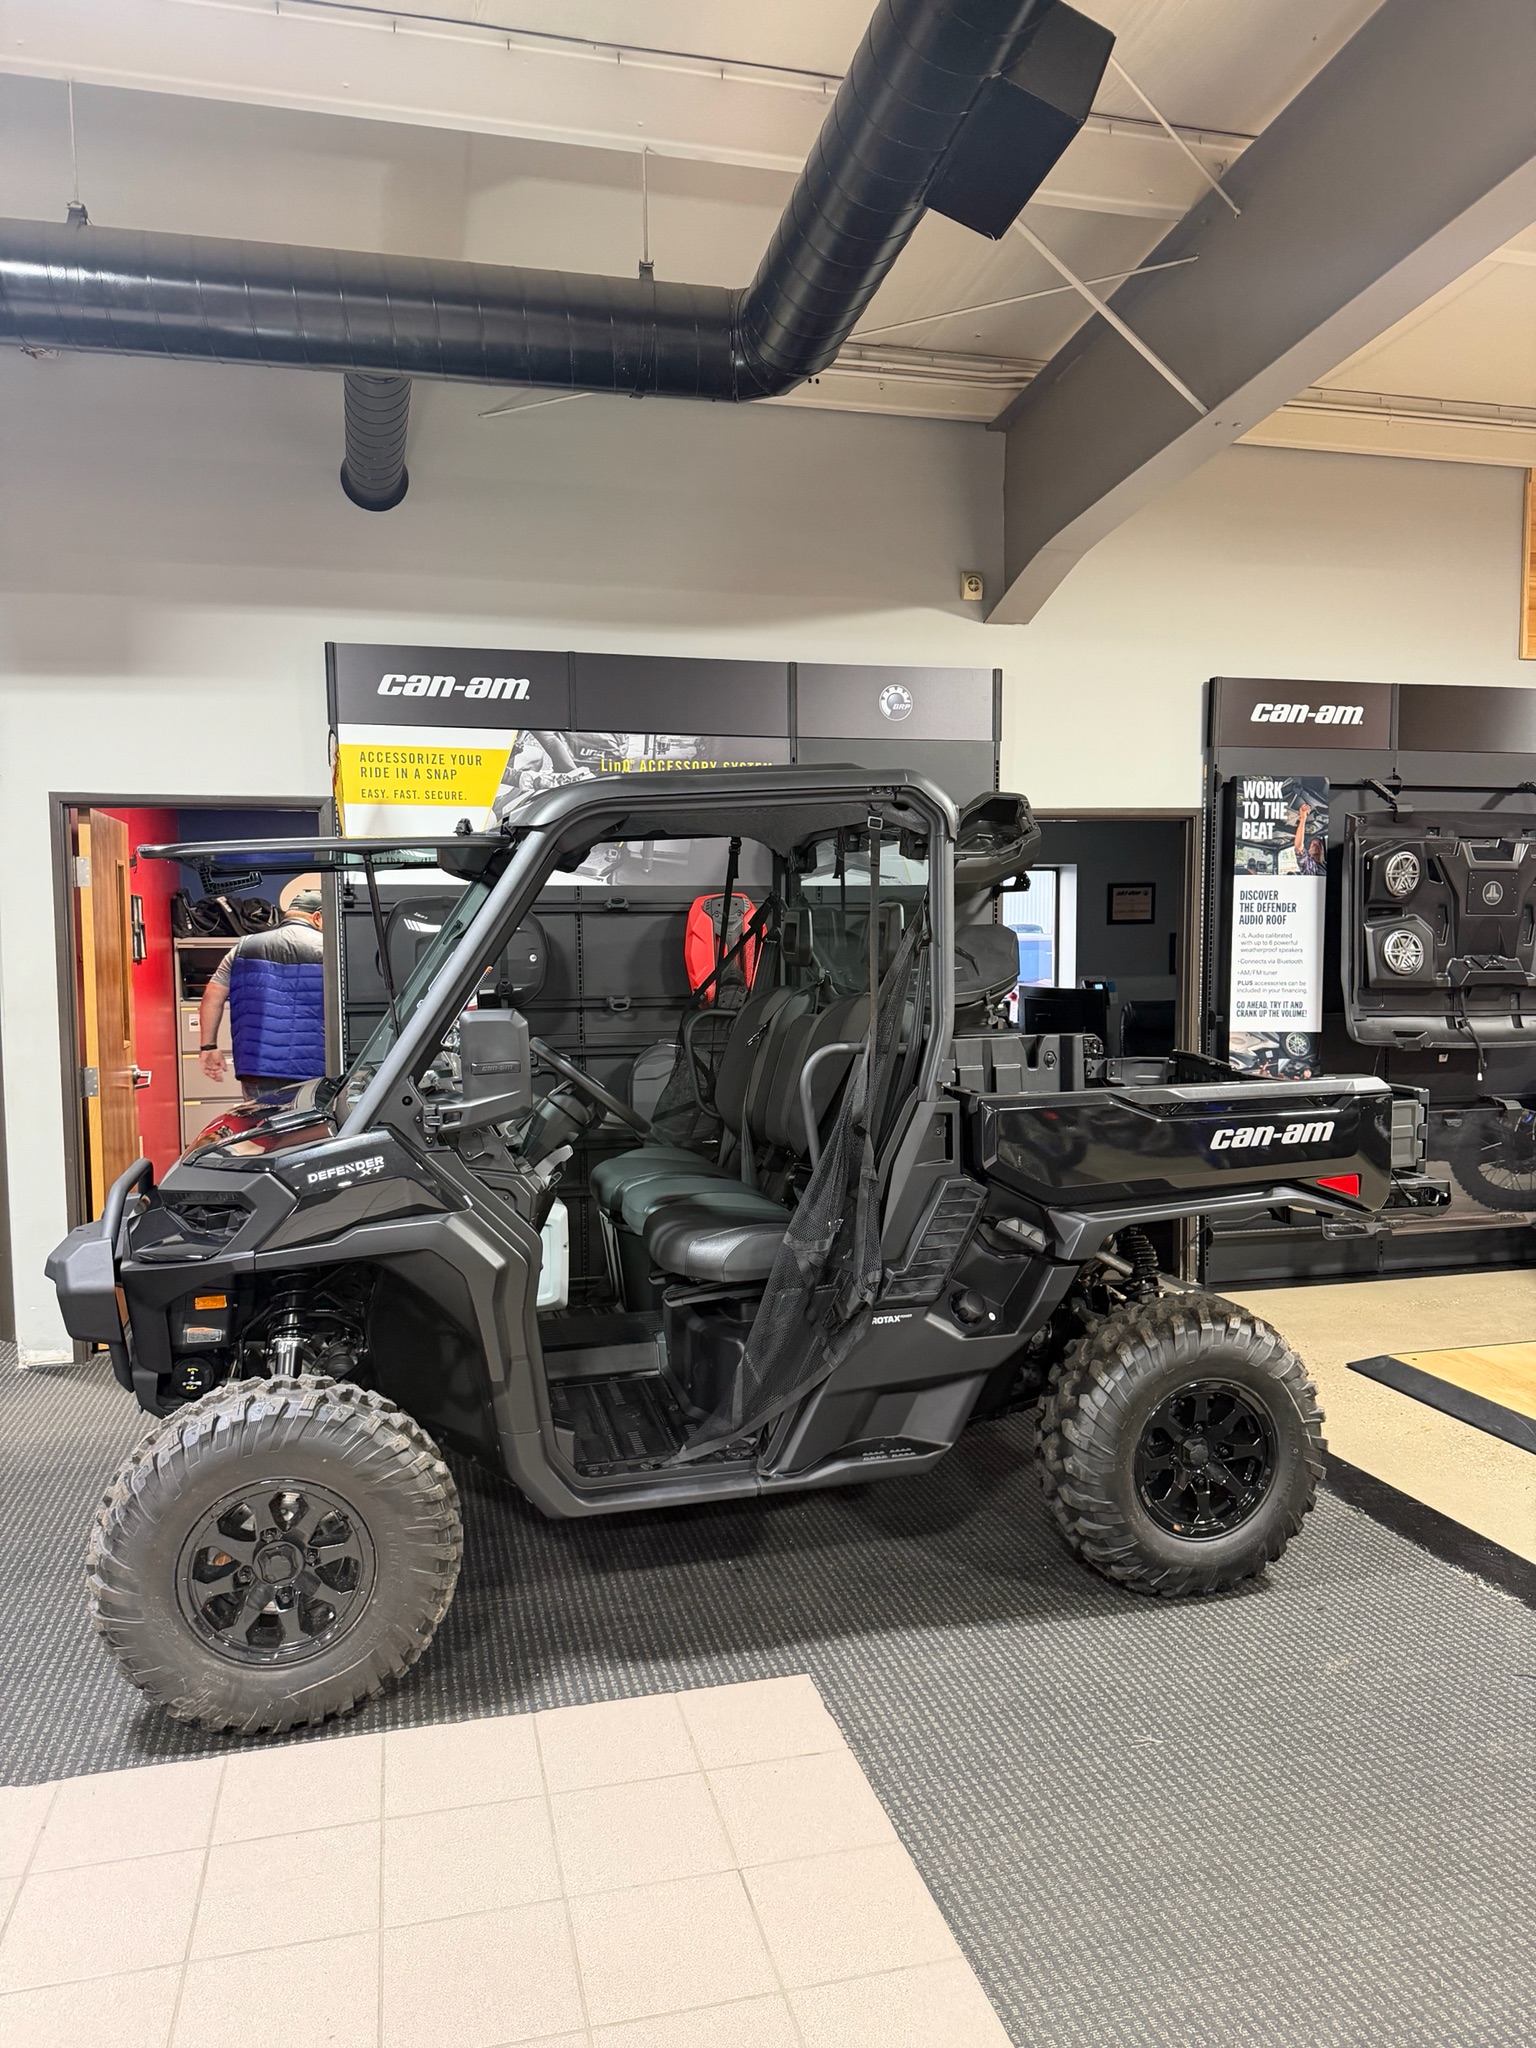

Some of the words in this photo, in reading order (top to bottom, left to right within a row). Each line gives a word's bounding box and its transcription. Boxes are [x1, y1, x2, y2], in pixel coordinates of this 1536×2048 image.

[360, 752, 445, 766] ACCESSORIZE
[450, 755, 482, 766] YOUR
[360, 767, 390, 778] RIDE
[396, 768, 408, 779] IN
[414, 768, 421, 779] A
[426, 769, 457, 780] SNAP
[361, 789, 389, 799] EASY.
[394, 790, 420, 800] FAST.
[425, 790, 467, 800] SECURE.
[1242, 781, 1284, 799] WORK
[1242, 802, 1260, 819] TO
[1263, 802, 1288, 820] THE
[1242, 822, 1275, 840] BEAT
[1240, 890, 1279, 900] DISCOVER
[1240, 903, 1254, 912] THE
[1257, 903, 1297, 913] DEFENDER
[1239, 915, 1263, 925] AUDIO
[1266, 915, 1287, 925] ROOF
[1247, 1001, 1268, 1009] AHEAD,
[1210, 1121, 1335, 1150] can-am
[307, 1156, 384, 1184] DEFENDER
[358, 1164, 384, 1178] XT
